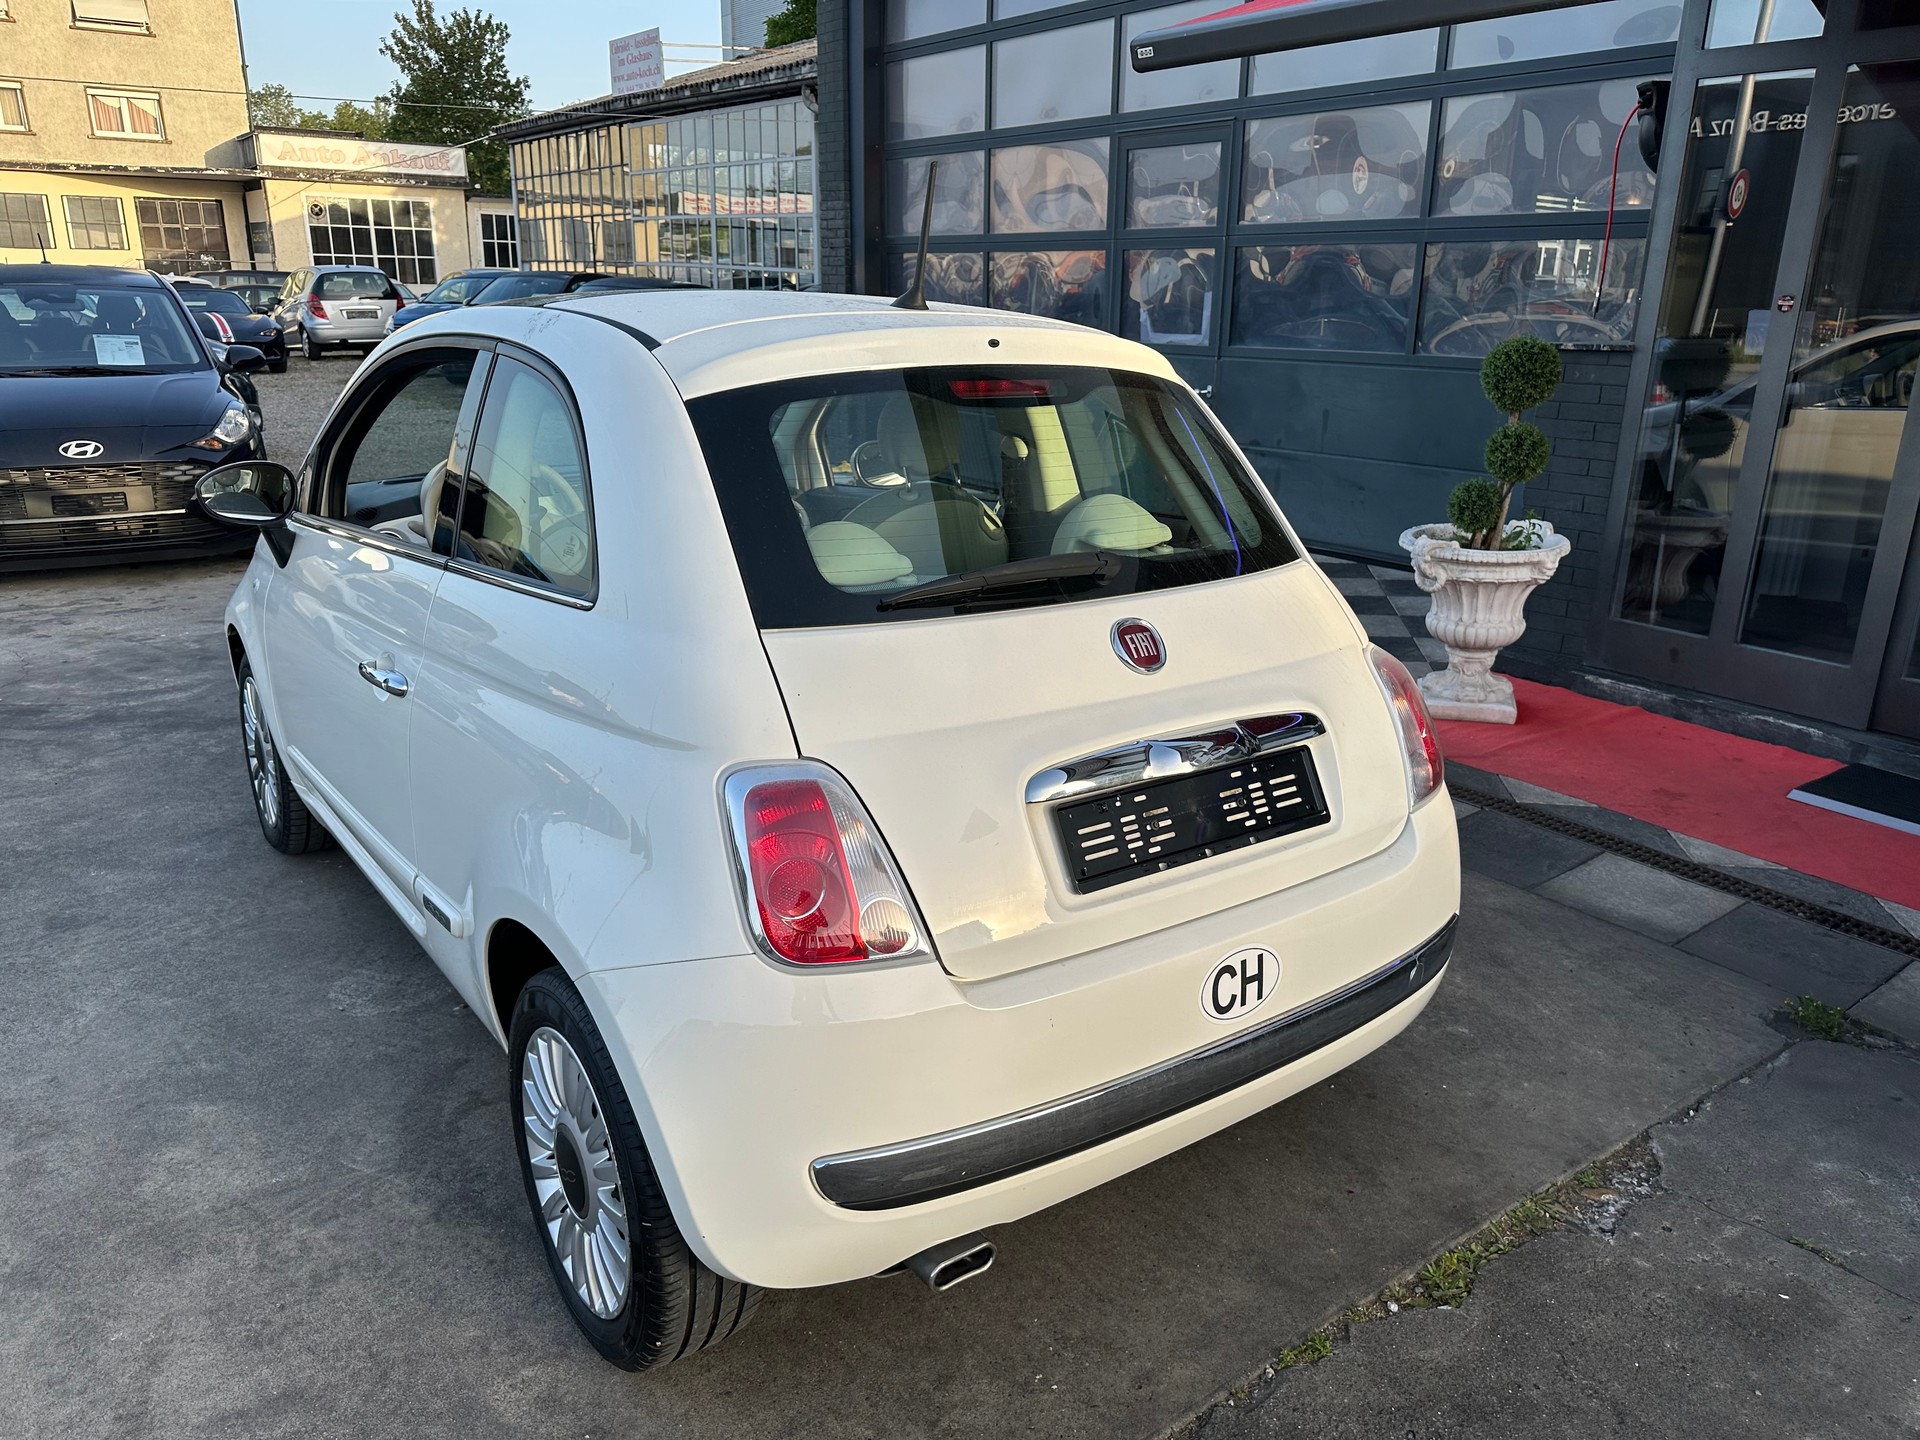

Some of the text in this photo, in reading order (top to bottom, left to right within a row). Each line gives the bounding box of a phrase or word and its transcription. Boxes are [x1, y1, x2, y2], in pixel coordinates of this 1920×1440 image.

[613, 62, 660, 82] www.auto-koch.ch
[617, 50, 653, 67] im Glashaus
[277, 140, 450, 170] Auto Ankauf
[1124, 631, 1157, 659] FIAT
[1212, 953, 1264, 1015] CH
